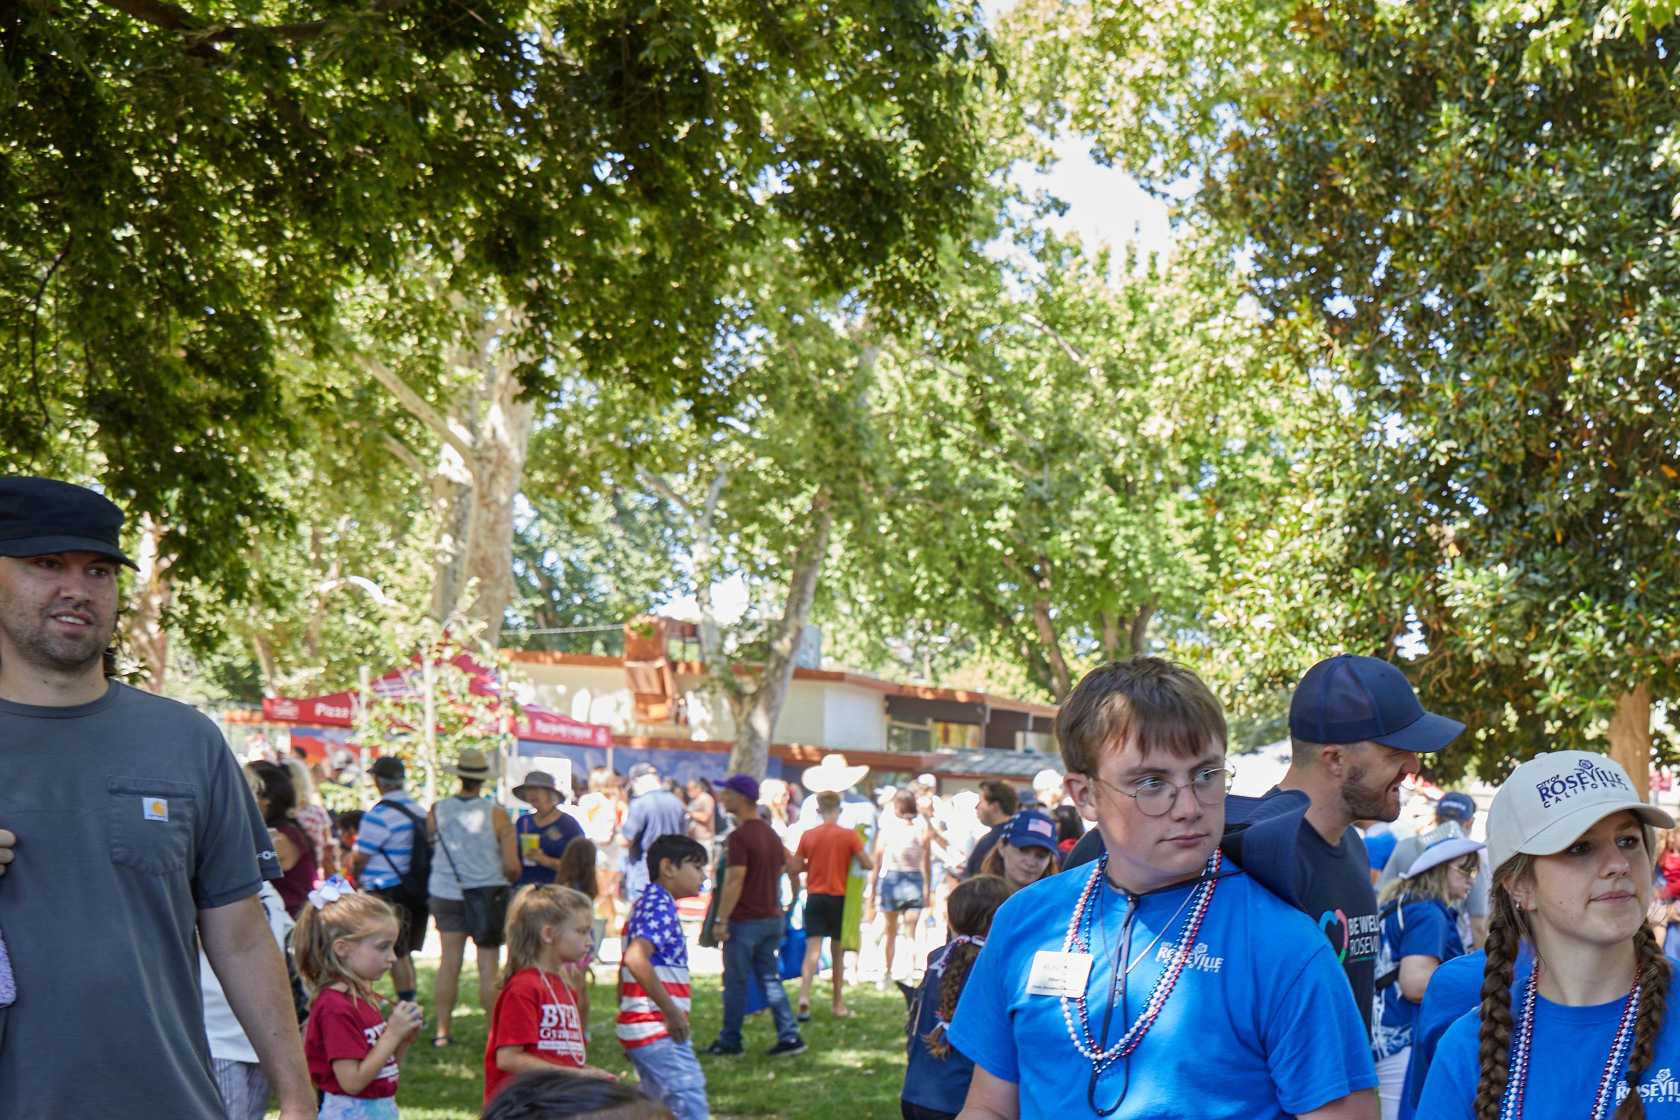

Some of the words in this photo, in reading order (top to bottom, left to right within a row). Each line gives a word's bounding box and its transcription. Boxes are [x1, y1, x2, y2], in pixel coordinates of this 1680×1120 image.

[1538, 766, 1627, 802] ROSEVILLE
[1348, 917, 1360, 936] BE
[1360, 914, 1380, 934] WEL
